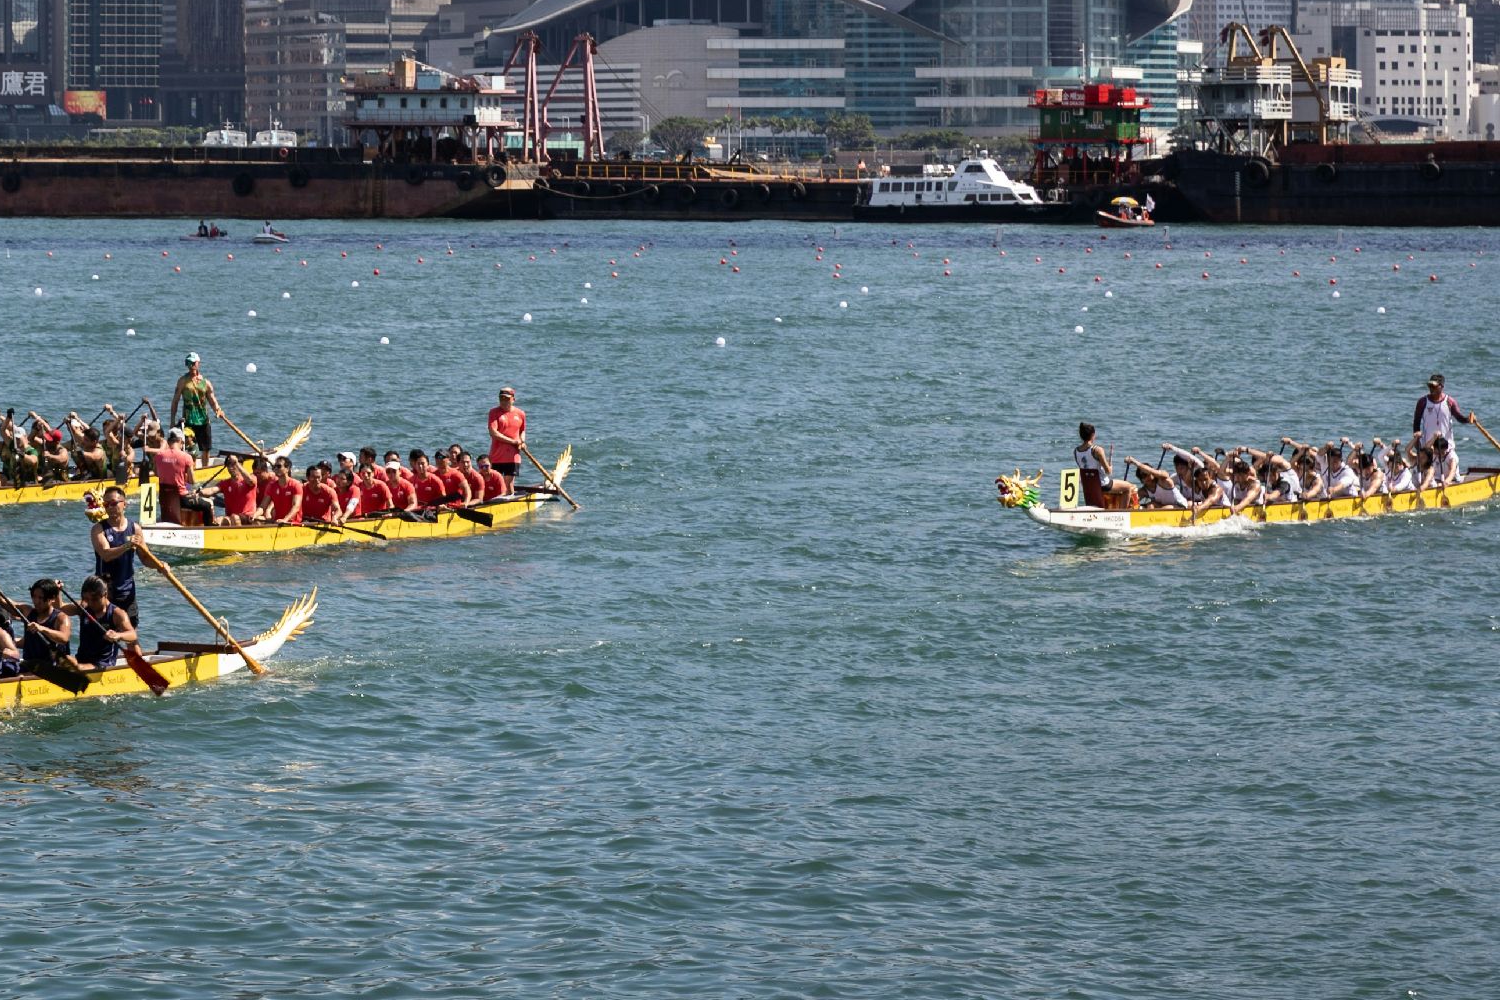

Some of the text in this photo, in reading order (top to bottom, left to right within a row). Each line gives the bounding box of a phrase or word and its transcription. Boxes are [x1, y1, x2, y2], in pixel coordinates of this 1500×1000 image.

[0, 71, 48, 96] 鷹君
[143, 486, 153, 518] 4
[1064, 472, 1075, 502] 5
